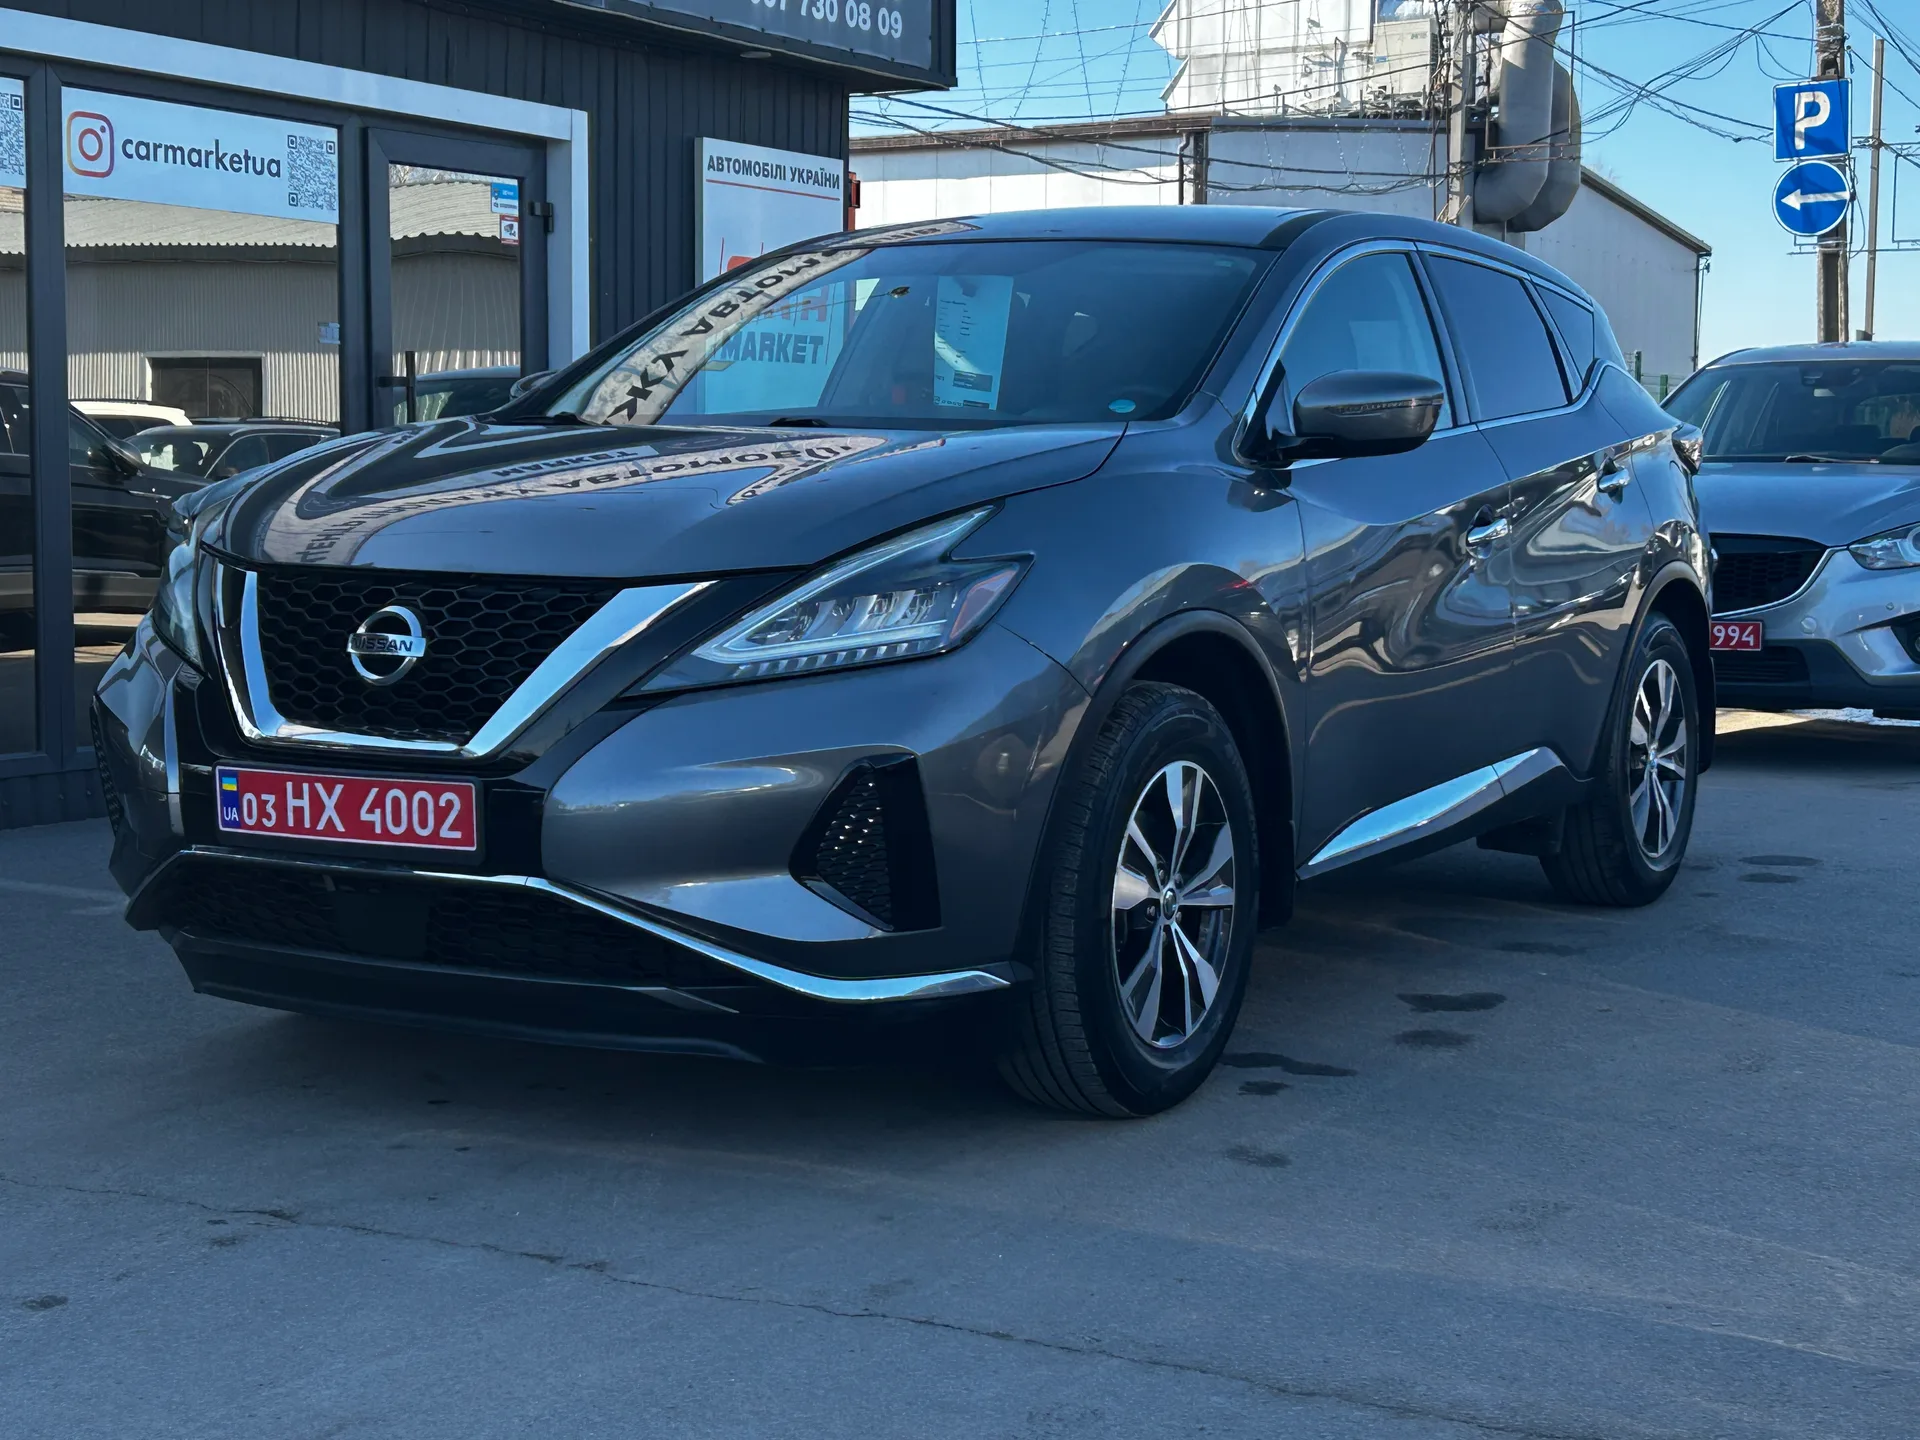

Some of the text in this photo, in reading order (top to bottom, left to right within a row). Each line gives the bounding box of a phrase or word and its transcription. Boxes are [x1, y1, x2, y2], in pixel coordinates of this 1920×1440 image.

[845, 1, 871, 31] 08
[878, 7, 903, 39] 09
[1794, 91, 1831, 150] P
[121, 139, 282, 178] carmarketua
[707, 154, 840, 190] АВТОМОБІЛІ УКРАЇНИ
[720, 331, 824, 365] MARKET
[352, 636, 413, 652] NISSAN
[1712, 625, 1755, 647] 994
[223, 806, 239, 822] UA
[242, 781, 462, 839] 03 HX 4002
